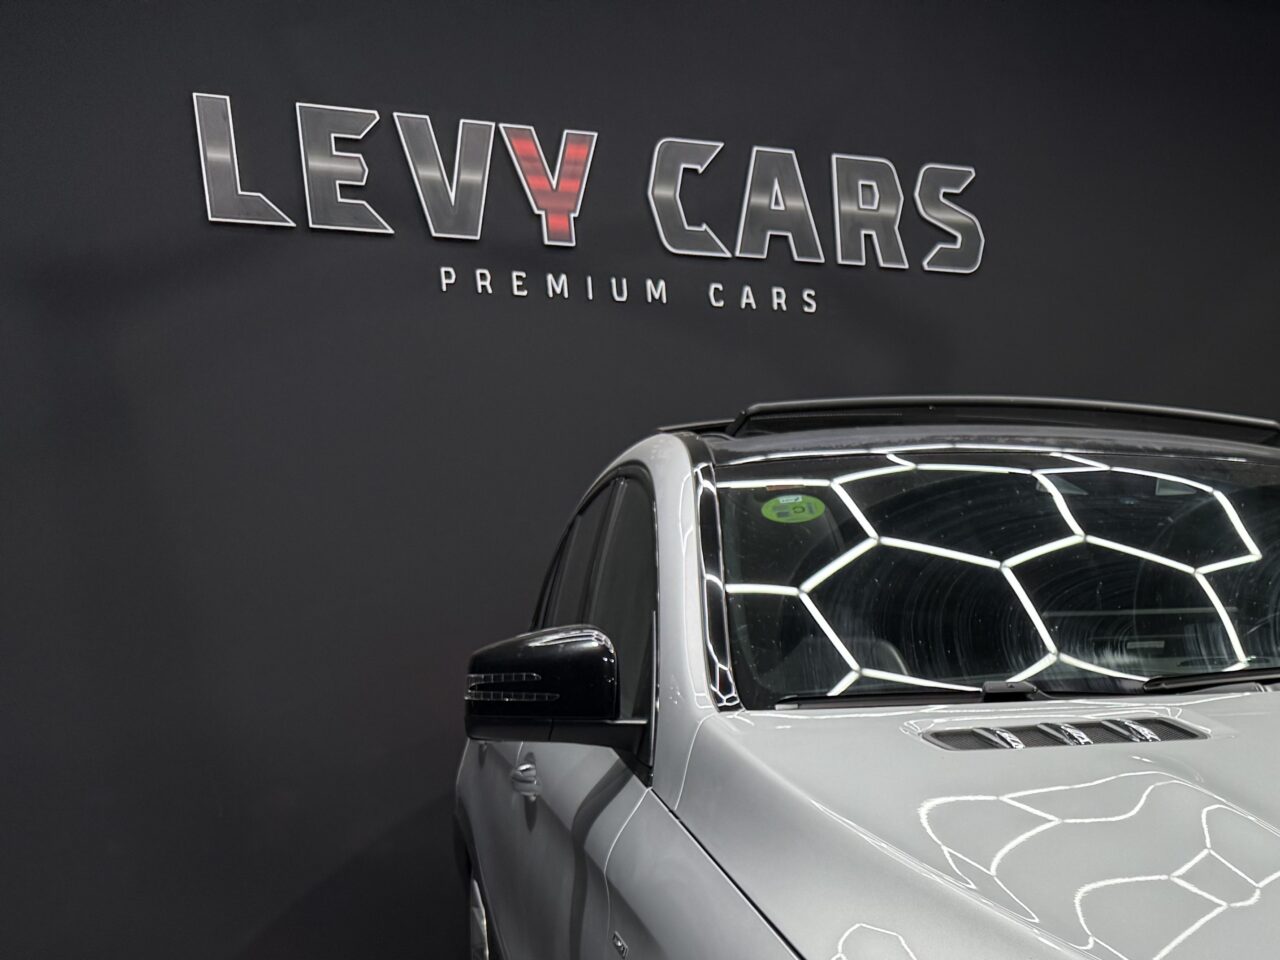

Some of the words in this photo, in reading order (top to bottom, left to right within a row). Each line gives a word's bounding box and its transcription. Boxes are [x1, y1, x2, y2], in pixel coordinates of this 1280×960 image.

[193, 92, 598, 246] LEVY
[647, 137, 985, 274] CARS
[440, 266, 668, 304] PREMIUM
[708, 282, 818, 313] CARS
